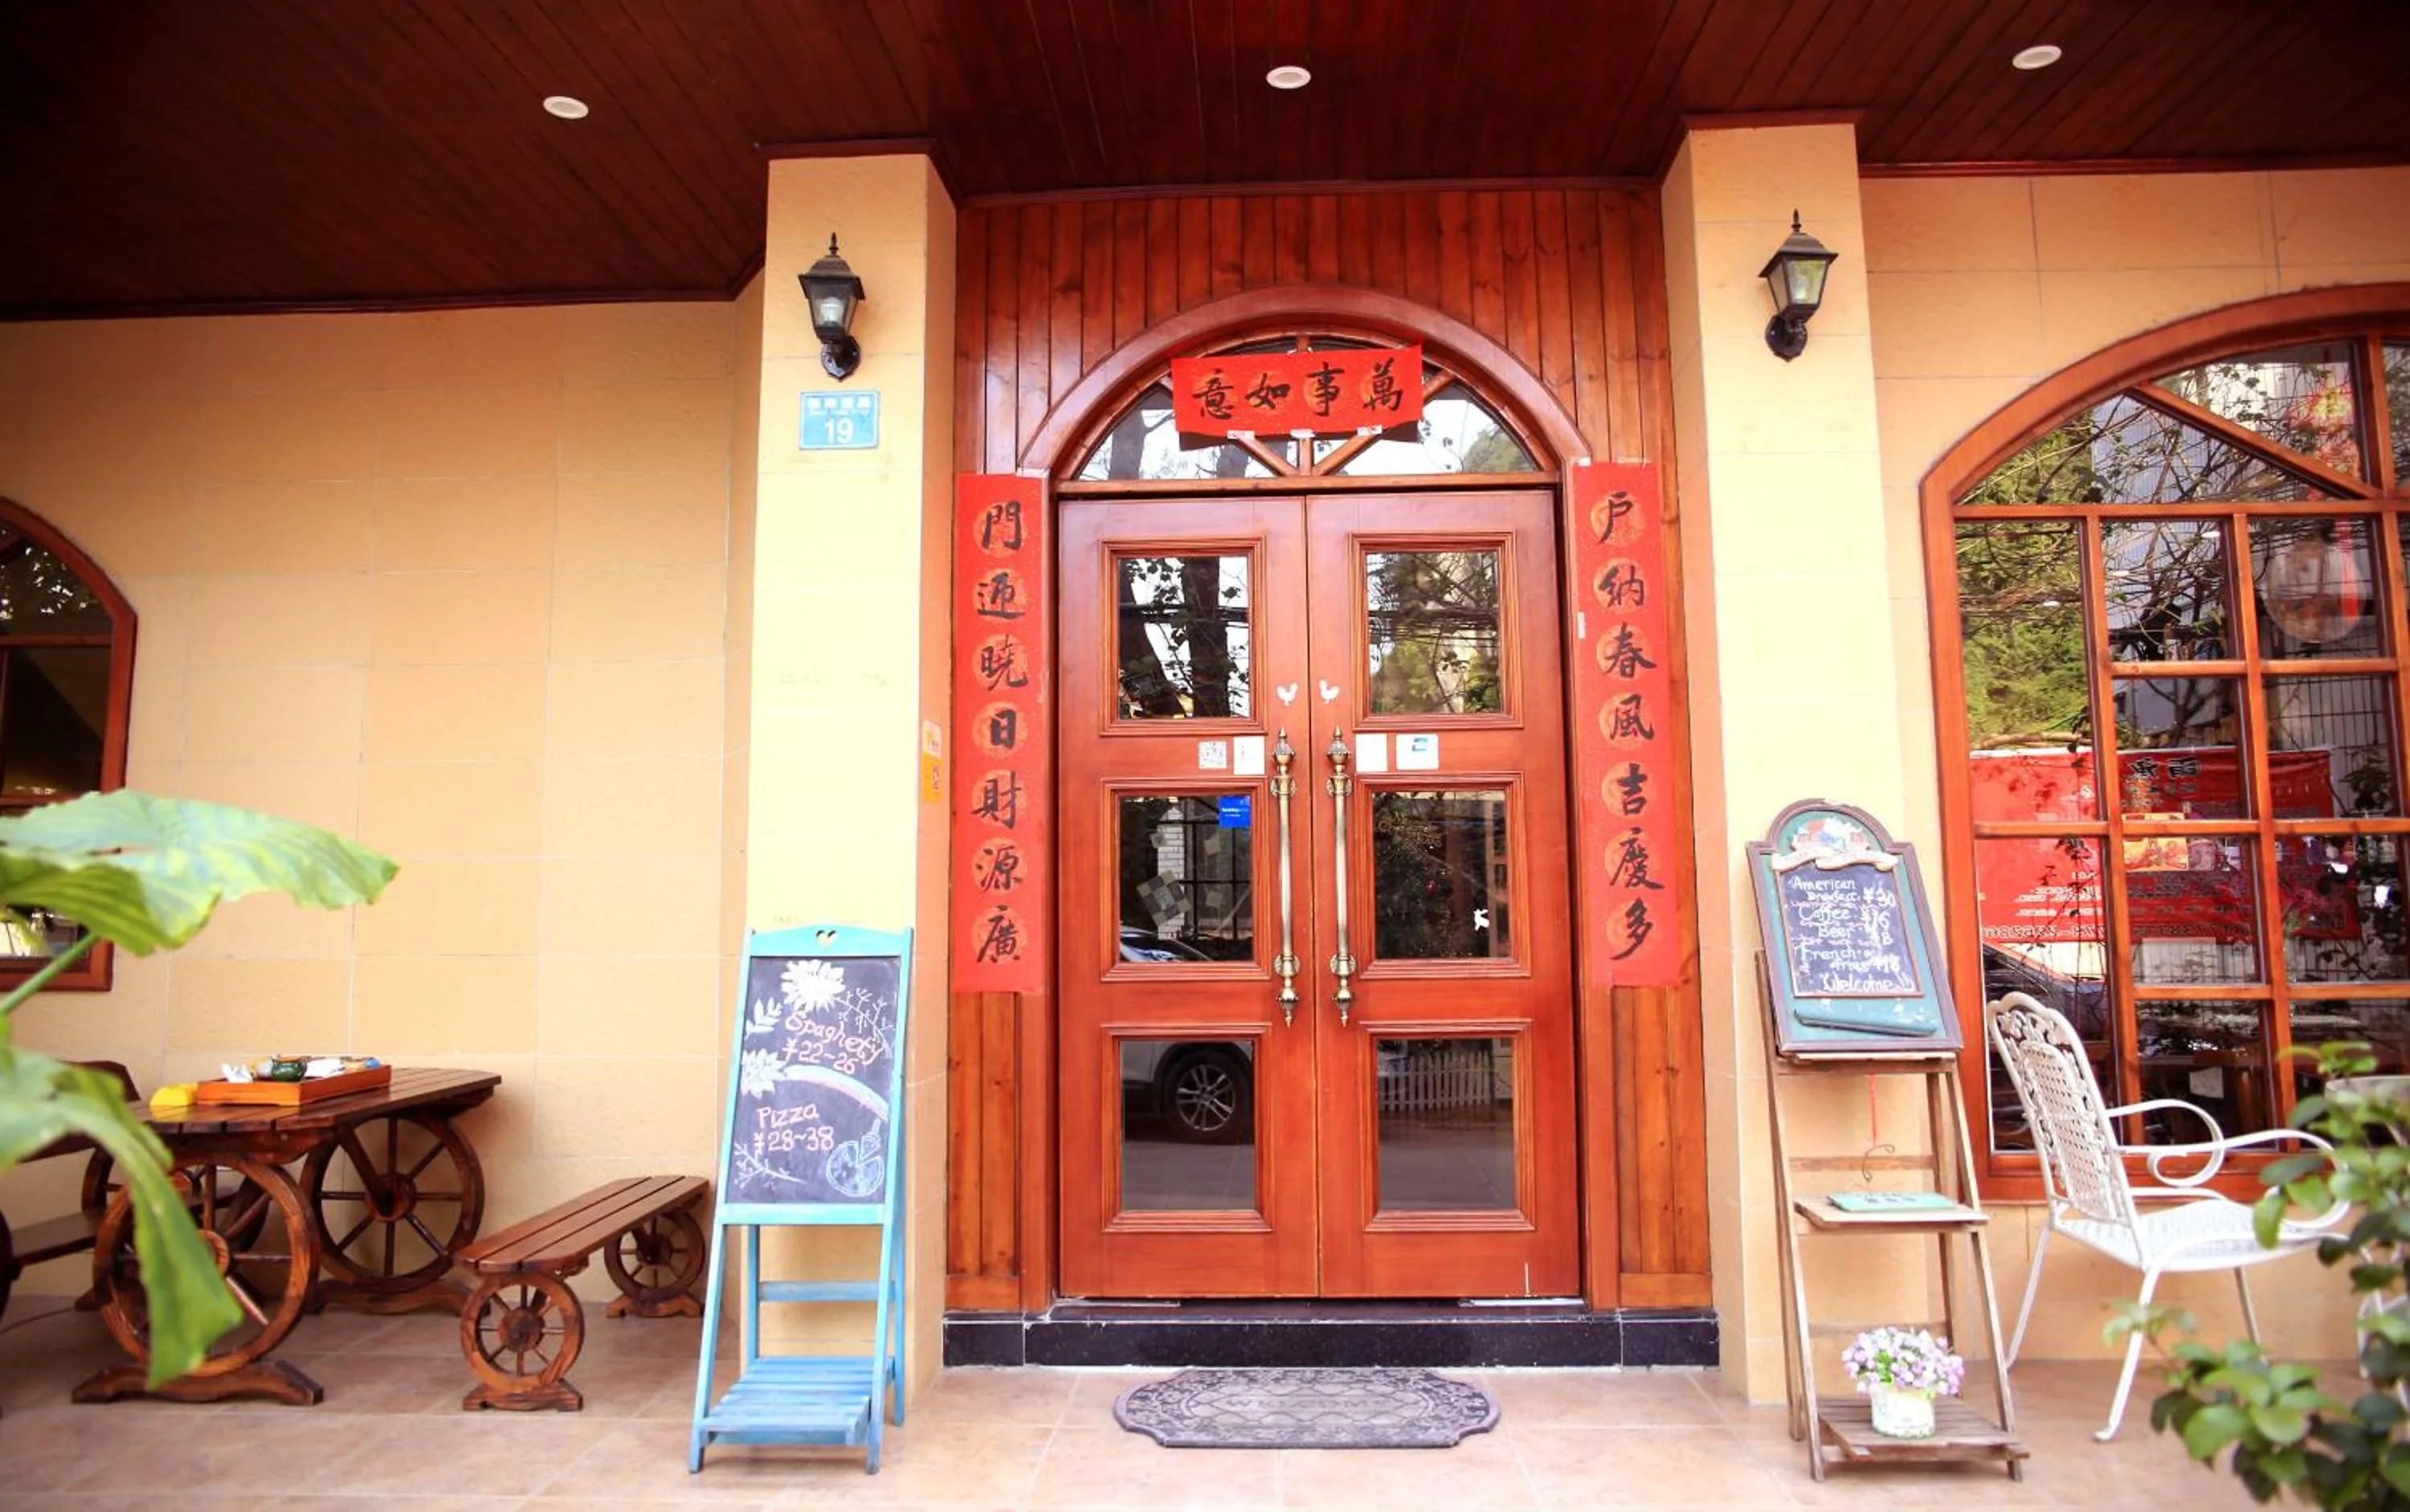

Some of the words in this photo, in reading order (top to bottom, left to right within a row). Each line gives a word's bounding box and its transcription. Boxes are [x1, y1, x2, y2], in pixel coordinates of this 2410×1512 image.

[824, 418, 854, 444] 19
[1793, 876, 1856, 890] American
[1818, 924, 1851, 938] Beer
[1795, 944, 1855, 961] French
[757, 1104, 819, 1129] Pizza
